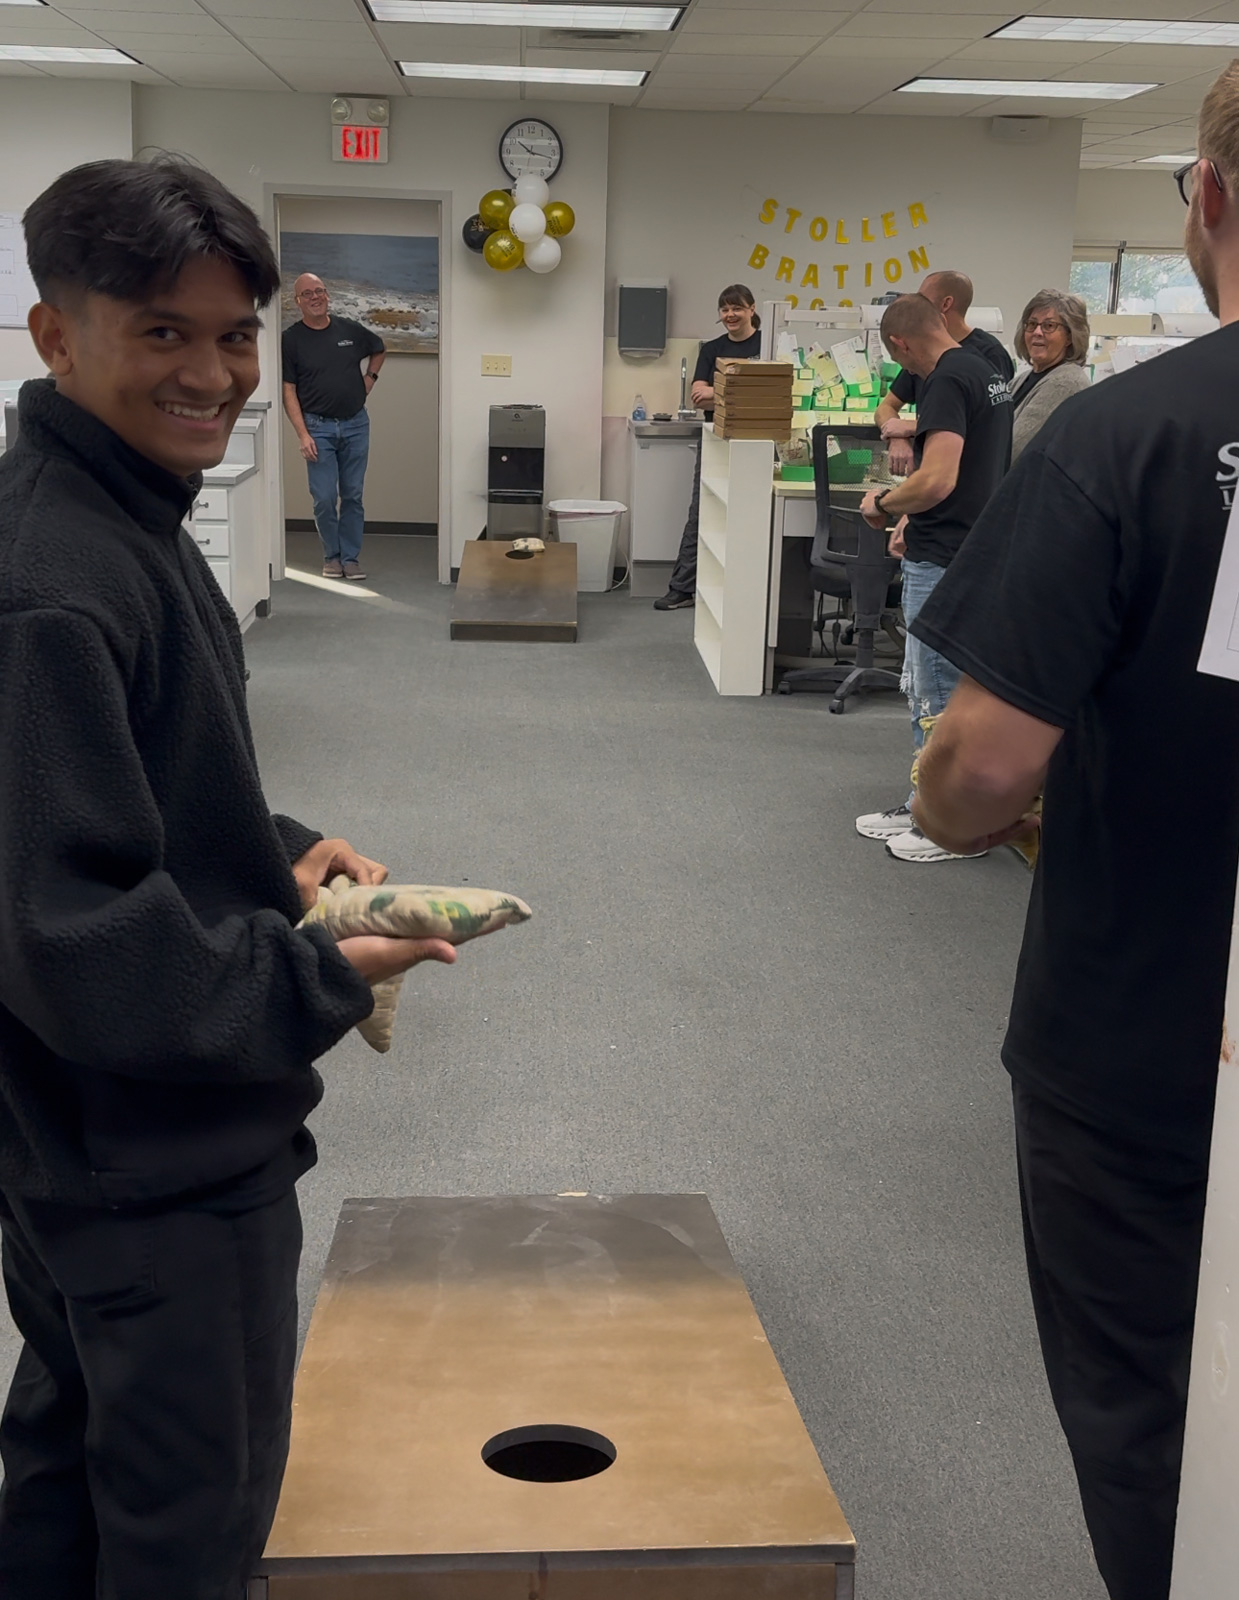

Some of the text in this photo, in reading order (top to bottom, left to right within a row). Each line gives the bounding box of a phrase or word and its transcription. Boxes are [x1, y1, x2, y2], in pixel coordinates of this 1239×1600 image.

[518, 128, 524, 136] 11
[527, 126, 536, 134] 12
[341, 126, 380, 161] EXIT
[510, 137, 517, 145] 10
[548, 137, 552, 145] 2
[759, 198, 928, 244] STOLLER
[747, 244, 930, 289] BRATION
